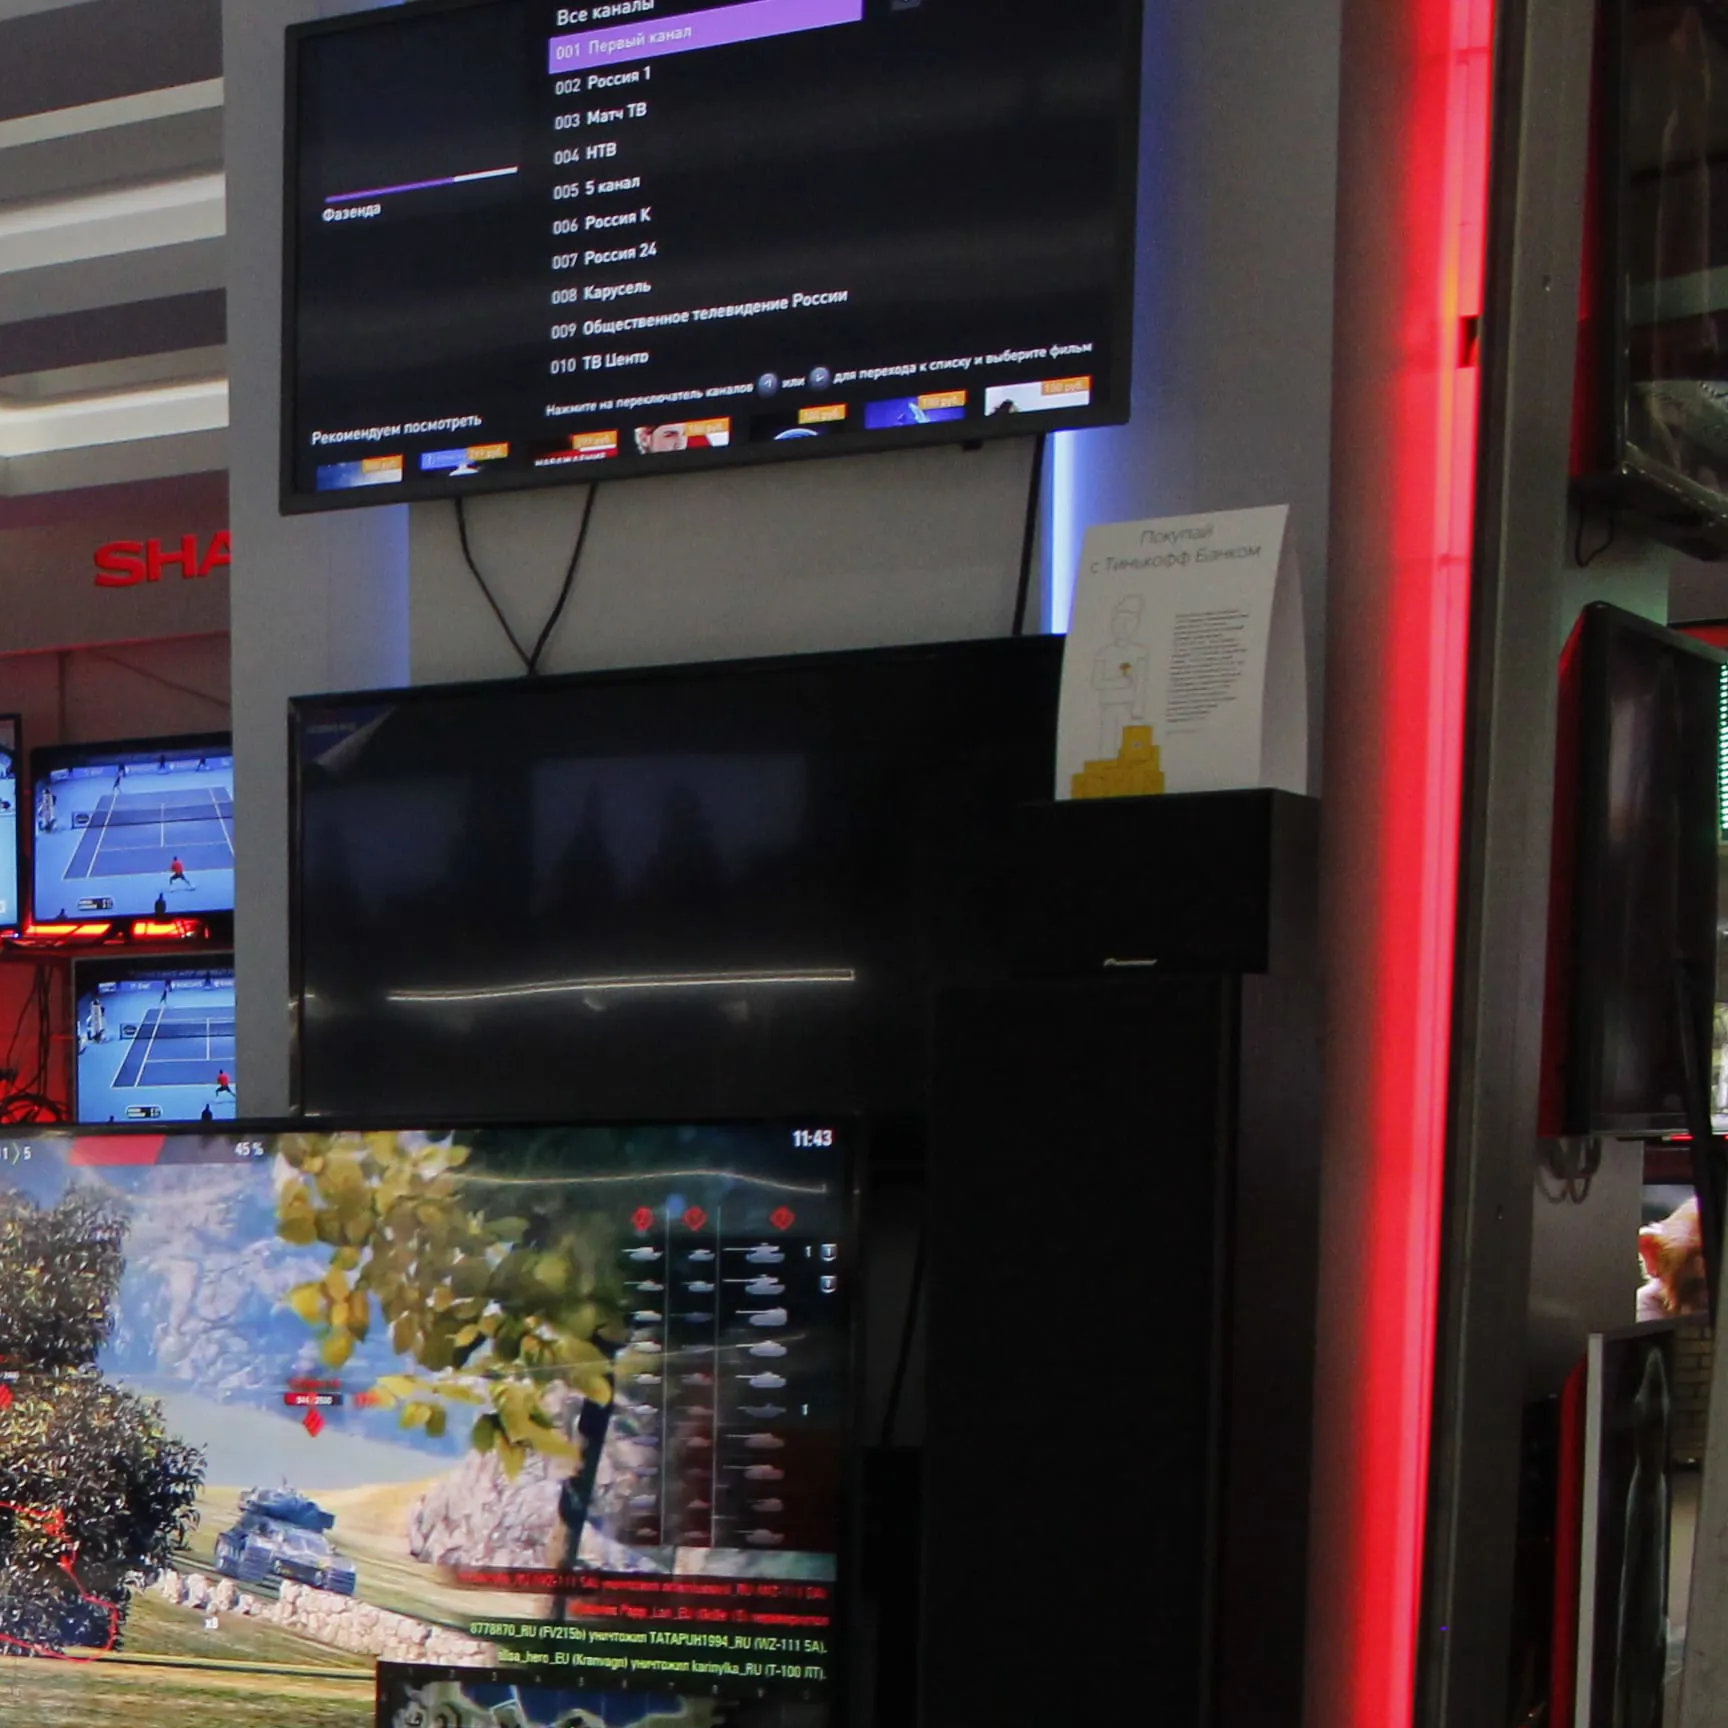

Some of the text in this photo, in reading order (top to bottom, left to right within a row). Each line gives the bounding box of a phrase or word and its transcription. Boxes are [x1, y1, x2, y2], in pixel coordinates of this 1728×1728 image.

[556, 0, 656, 26] Все каналы
[555, 25, 693, 60] 001 Первый канал
[554, 65, 652, 95] 002 Россия 1
[554, 101, 648, 131] 003 Матч ТВ
[553, 142, 618, 166] 004 НТВ
[553, 175, 642, 200] 005 5 канал
[321, 202, 382, 222] Фазенда
[552, 206, 652, 236] 006 Россия К
[551, 241, 658, 270] 007 Россия 24
[550, 281, 652, 305] 008 Карусель
[550, 289, 849, 340] 009 Общественное телевидение России
[549, 350, 650, 375] 010 ТВ Центр
[545, 400, 597, 417] Нажмите
[599, 400, 614, 411] на
[615, 387, 704, 410] переключатель
[705, 381, 755, 398] каналов
[832, 369, 857, 385] для
[858, 363, 917, 382] перехода
[928, 355, 972, 373] списку
[985, 347, 1048, 366] выберите
[1049, 340, 1093, 360] фильм
[311, 412, 483, 446] Рекомендуем посмотреть
[1140, 523, 1215, 546] Покупай
[1105, 550, 1192, 573] Тинькофф
[1195, 544, 1262, 565] Банком
[234, 1142, 251, 1156] 45
[792, 1129, 833, 1147] 11:43
[23, 1146, 32, 1161] 5
